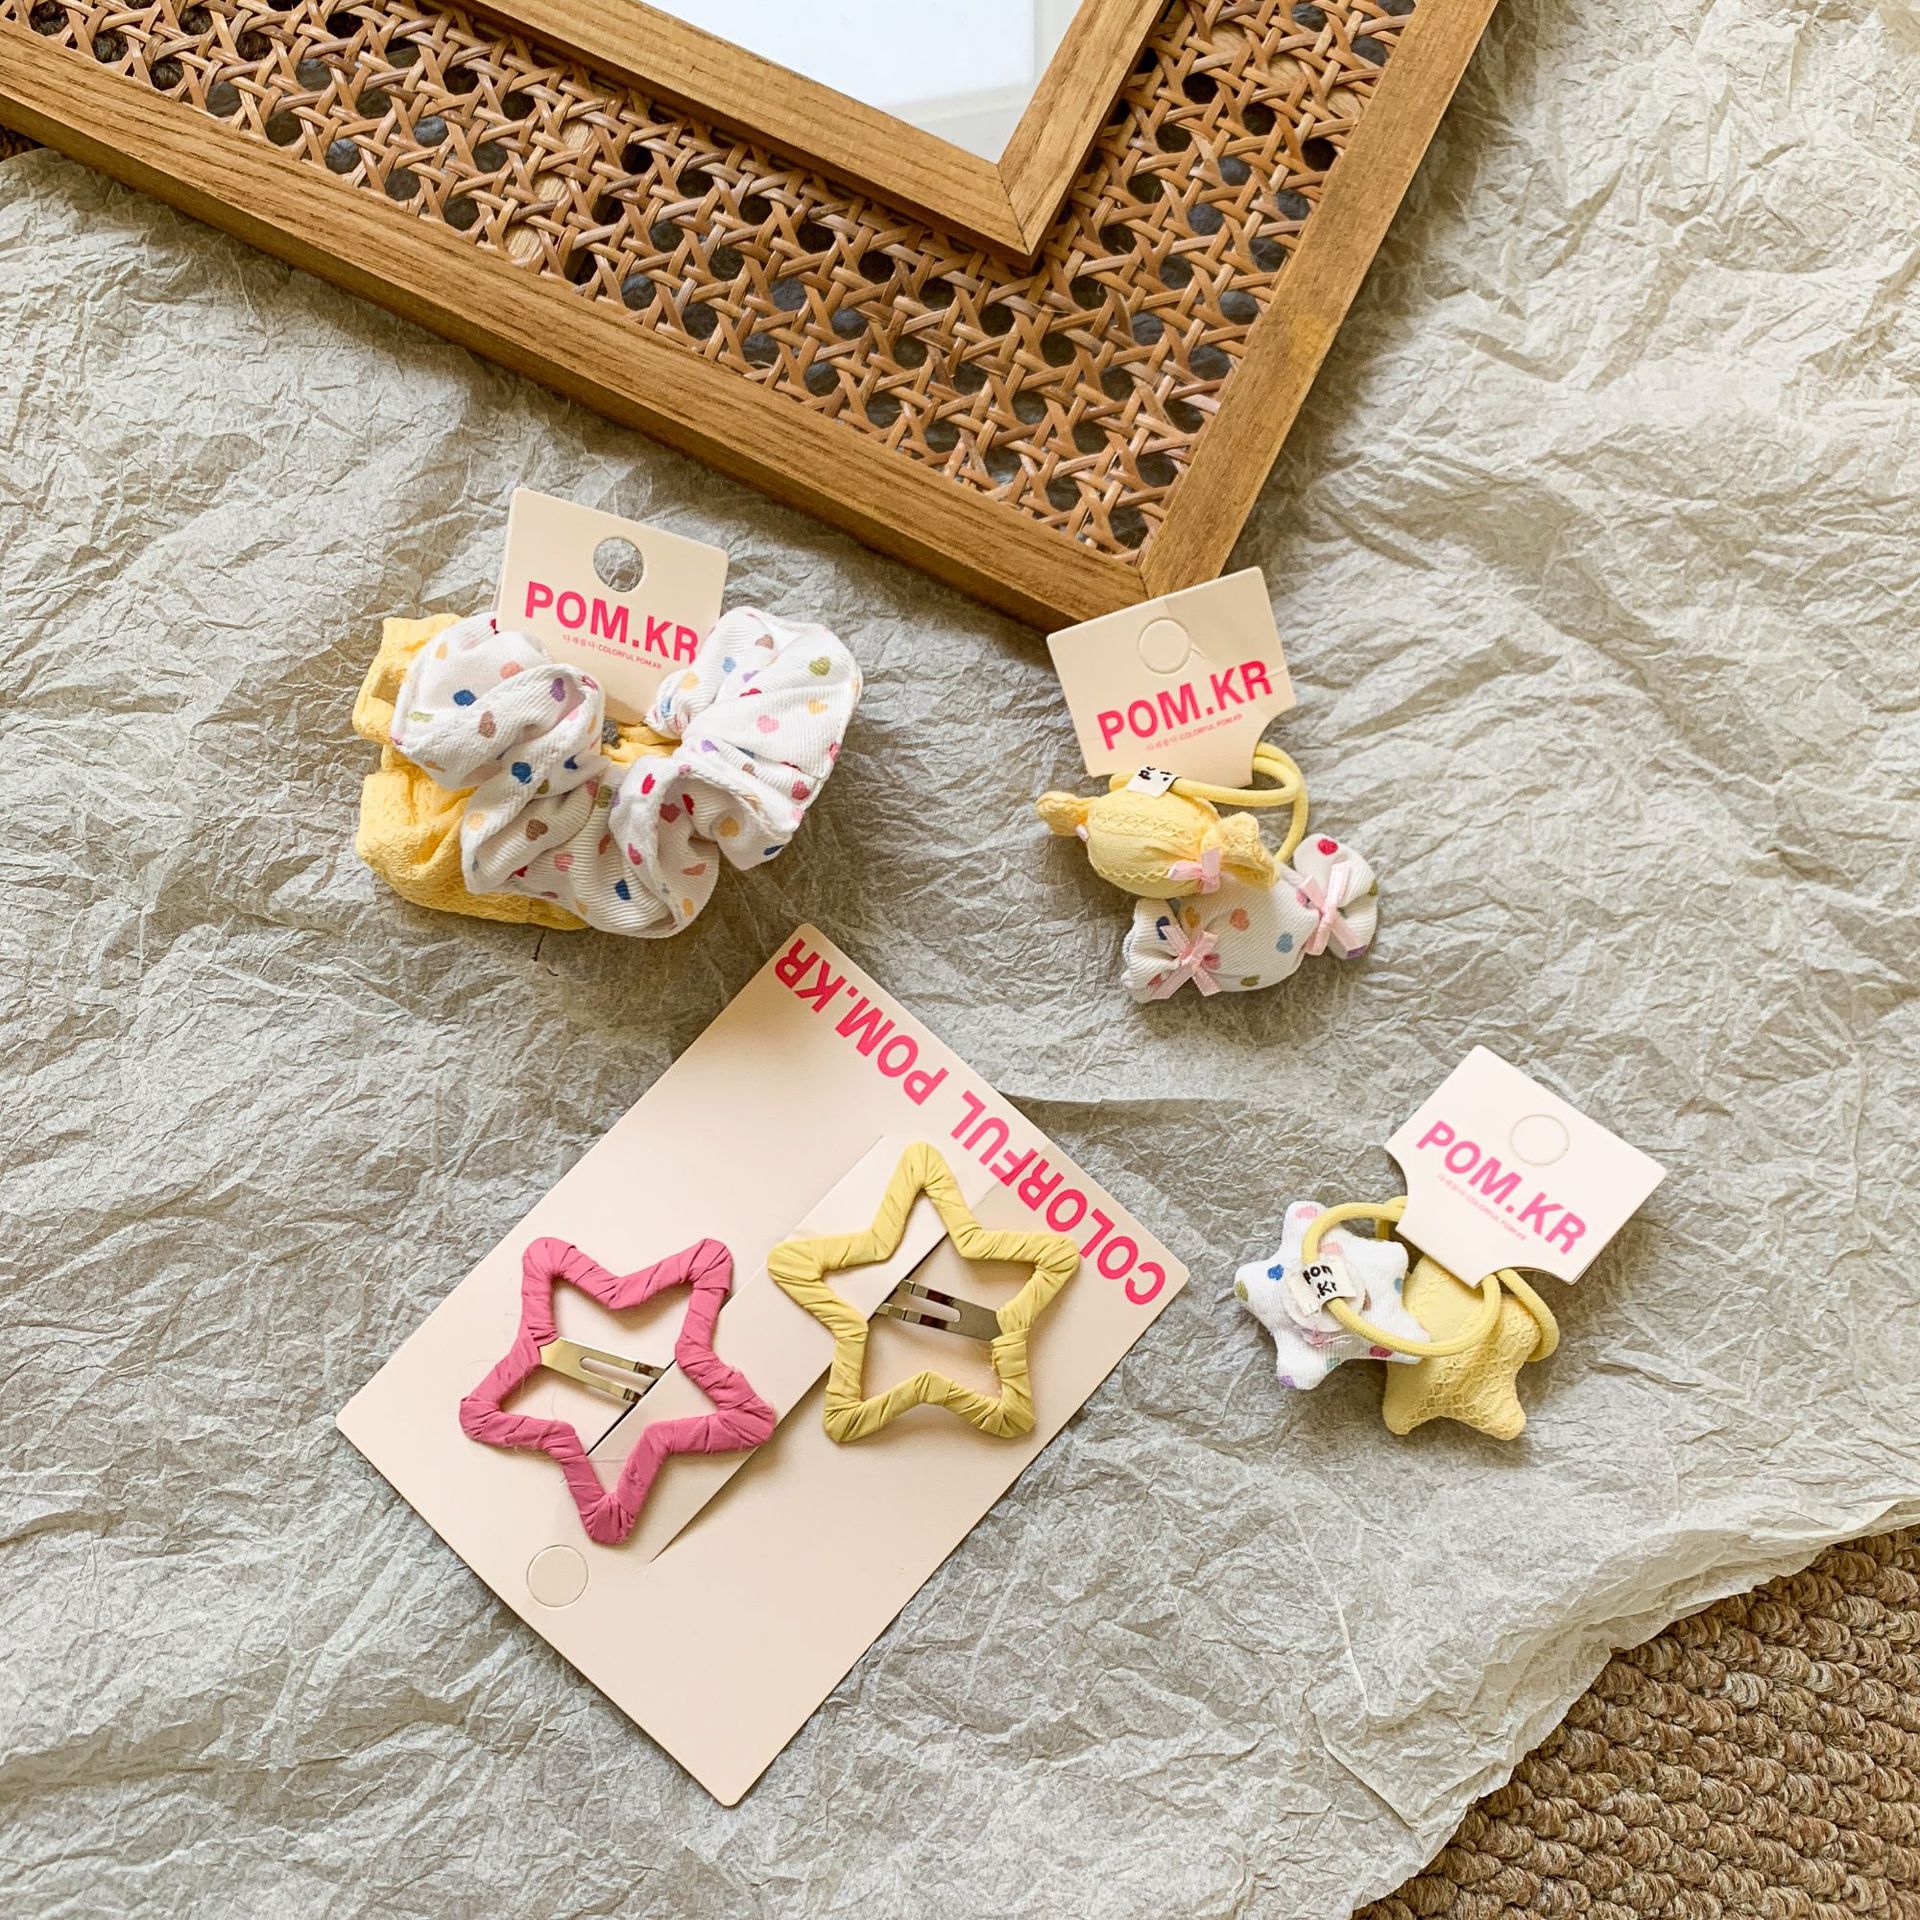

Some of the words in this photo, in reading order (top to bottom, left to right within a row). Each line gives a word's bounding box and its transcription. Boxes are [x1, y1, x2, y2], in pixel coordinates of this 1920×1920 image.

[525, 581, 698, 664] POM.KR
[598, 645, 634, 661] COLORFUL
[636, 656, 662, 669] POM.KR
[1097, 660, 1273, 751] POM.KR
[774, 938, 949, 1106] POM.KR
[950, 1090, 1166, 1305] COLORFUL
[1416, 1120, 1586, 1254] POM.KR
